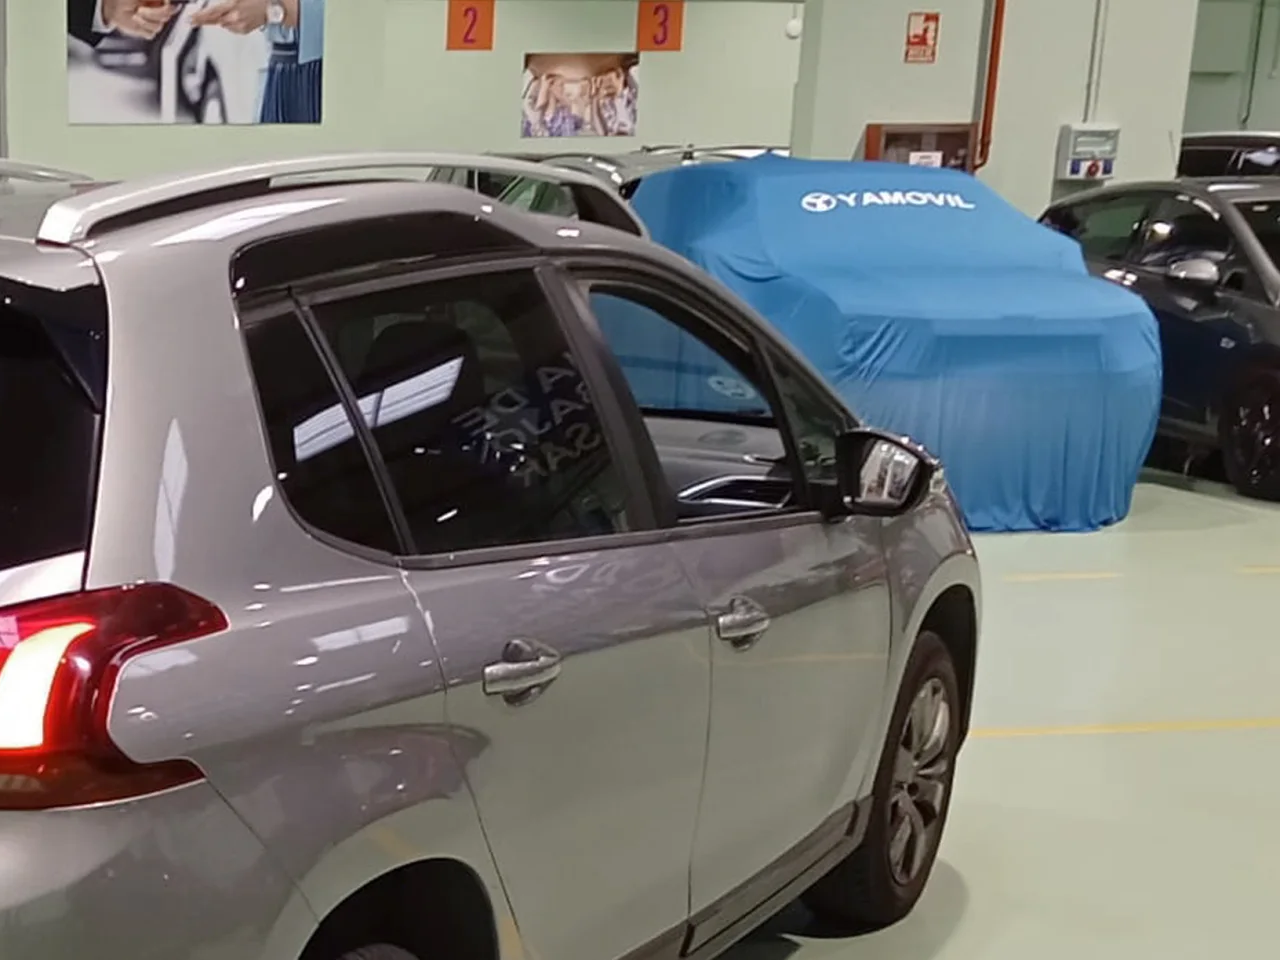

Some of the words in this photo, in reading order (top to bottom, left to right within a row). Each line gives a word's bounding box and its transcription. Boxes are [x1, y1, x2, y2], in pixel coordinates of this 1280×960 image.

[462, 7, 478, 43] 2
[652, 4, 669, 45] 3
[836, 191, 976, 209] YAMOVIL
